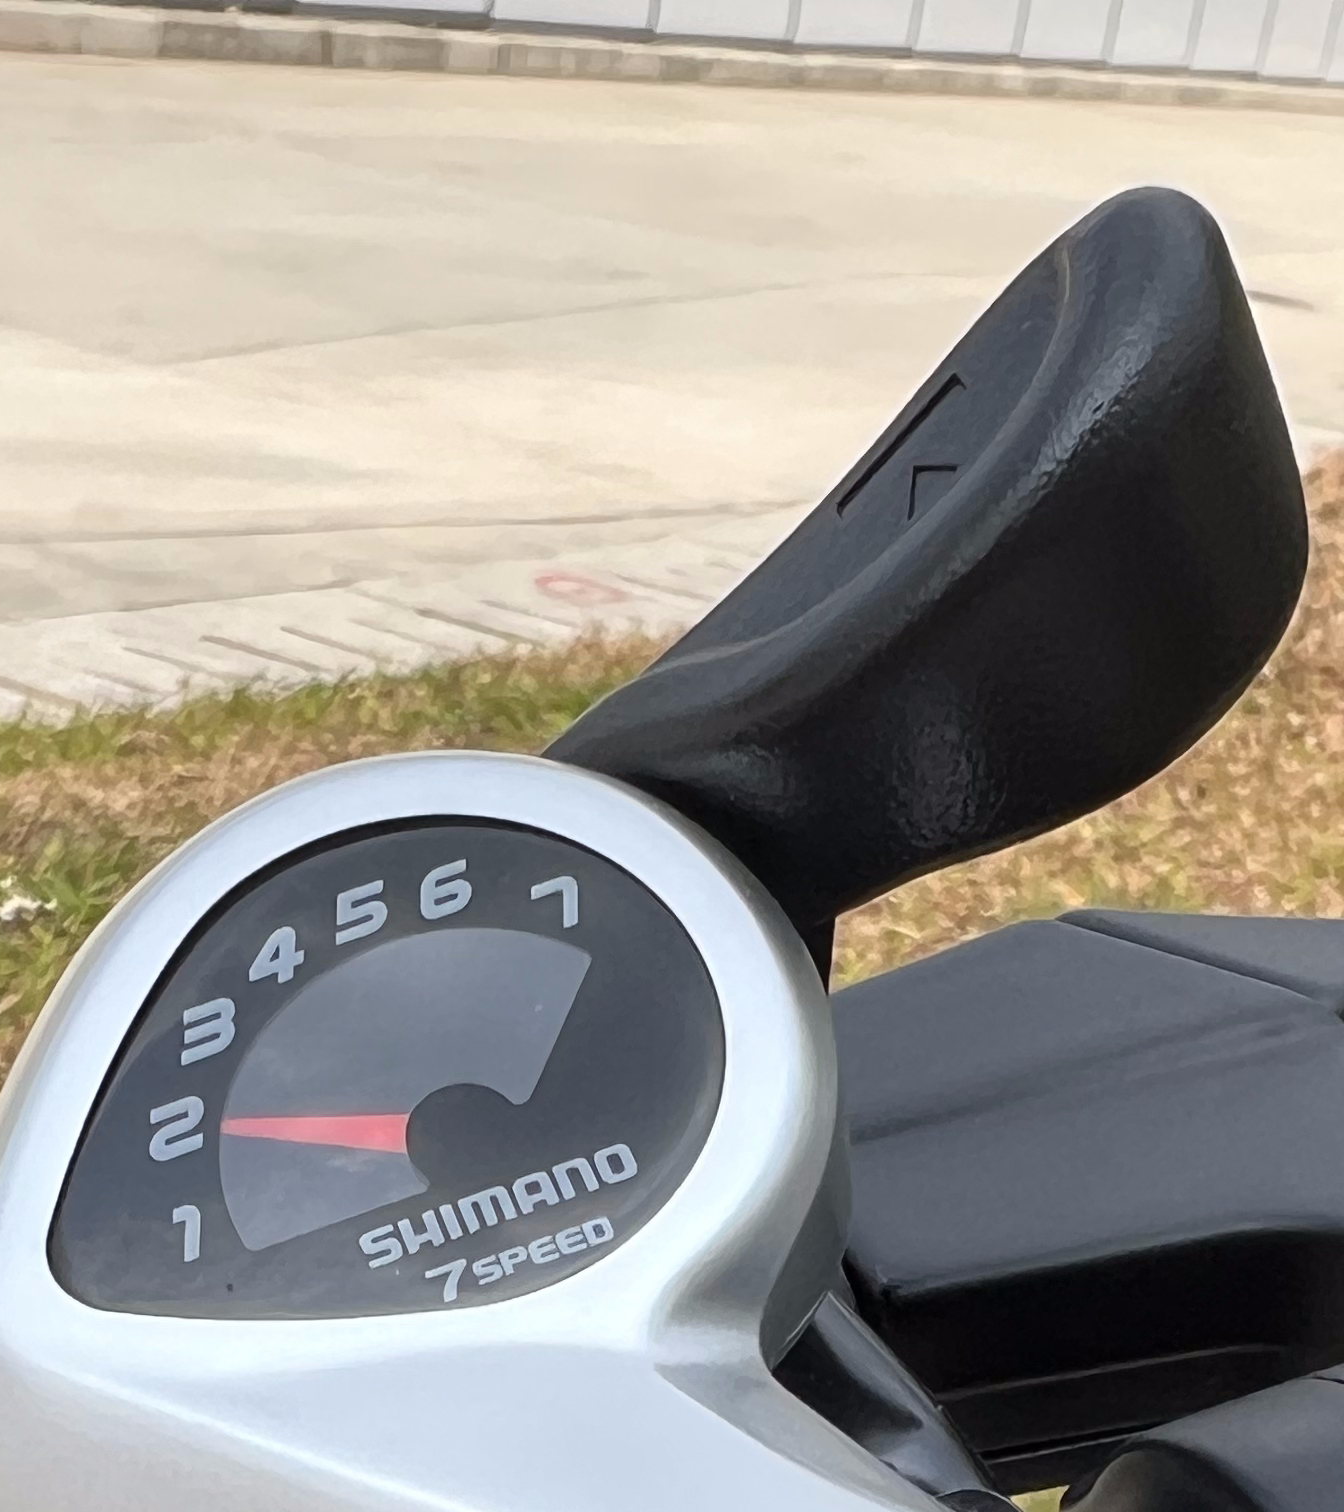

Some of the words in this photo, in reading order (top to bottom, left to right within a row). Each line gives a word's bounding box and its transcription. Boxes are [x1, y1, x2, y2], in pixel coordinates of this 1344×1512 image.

[335, 879, 389, 945] 5
[420, 858, 473, 920] 6
[529, 875, 580, 929] 7
[248, 925, 305, 984] 4
[180, 996, 237, 1066] 3
[148, 1095, 205, 1162] 2
[172, 1204, 202, 1263] 1
[358, 1143, 639, 1270] SHIMANO
